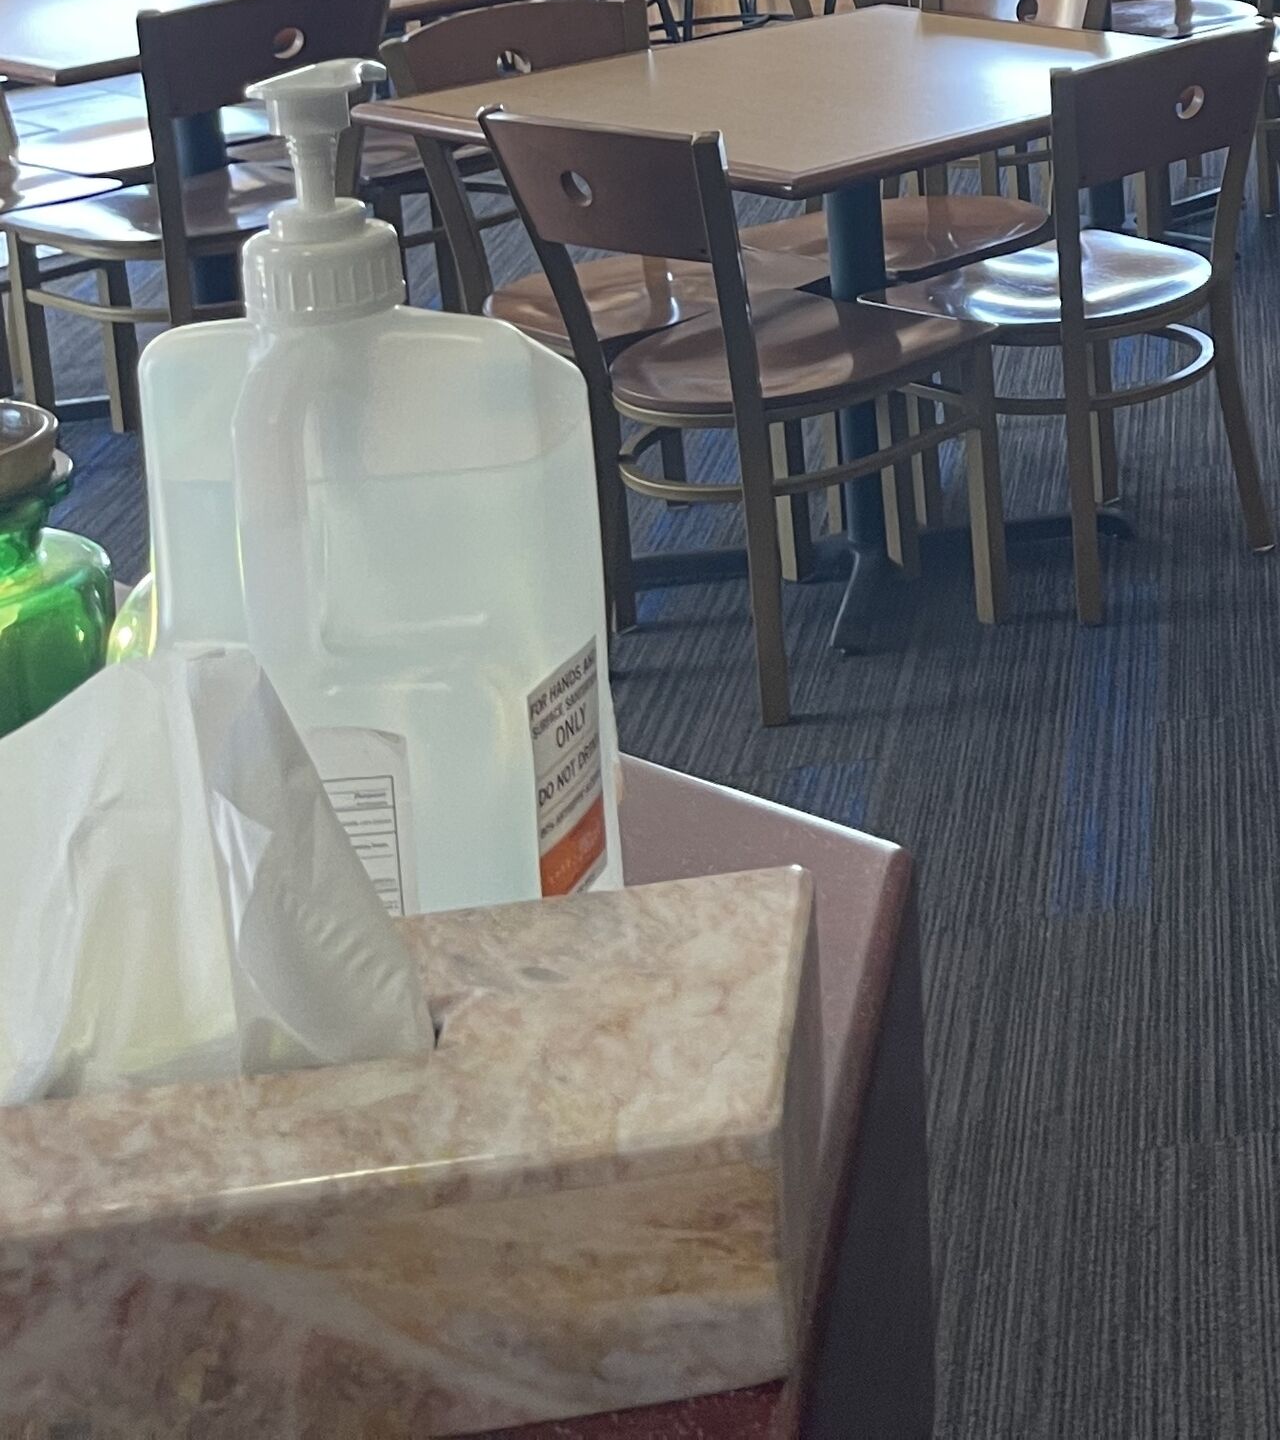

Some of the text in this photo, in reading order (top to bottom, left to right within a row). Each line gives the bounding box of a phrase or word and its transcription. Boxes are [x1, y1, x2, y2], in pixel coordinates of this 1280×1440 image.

[530, 693, 548, 721] FOR
[549, 664, 582, 703] HANDS
[555, 702, 587, 748] ONLY
[538, 781, 555, 807] DO
[556, 758, 576, 791] NOT
